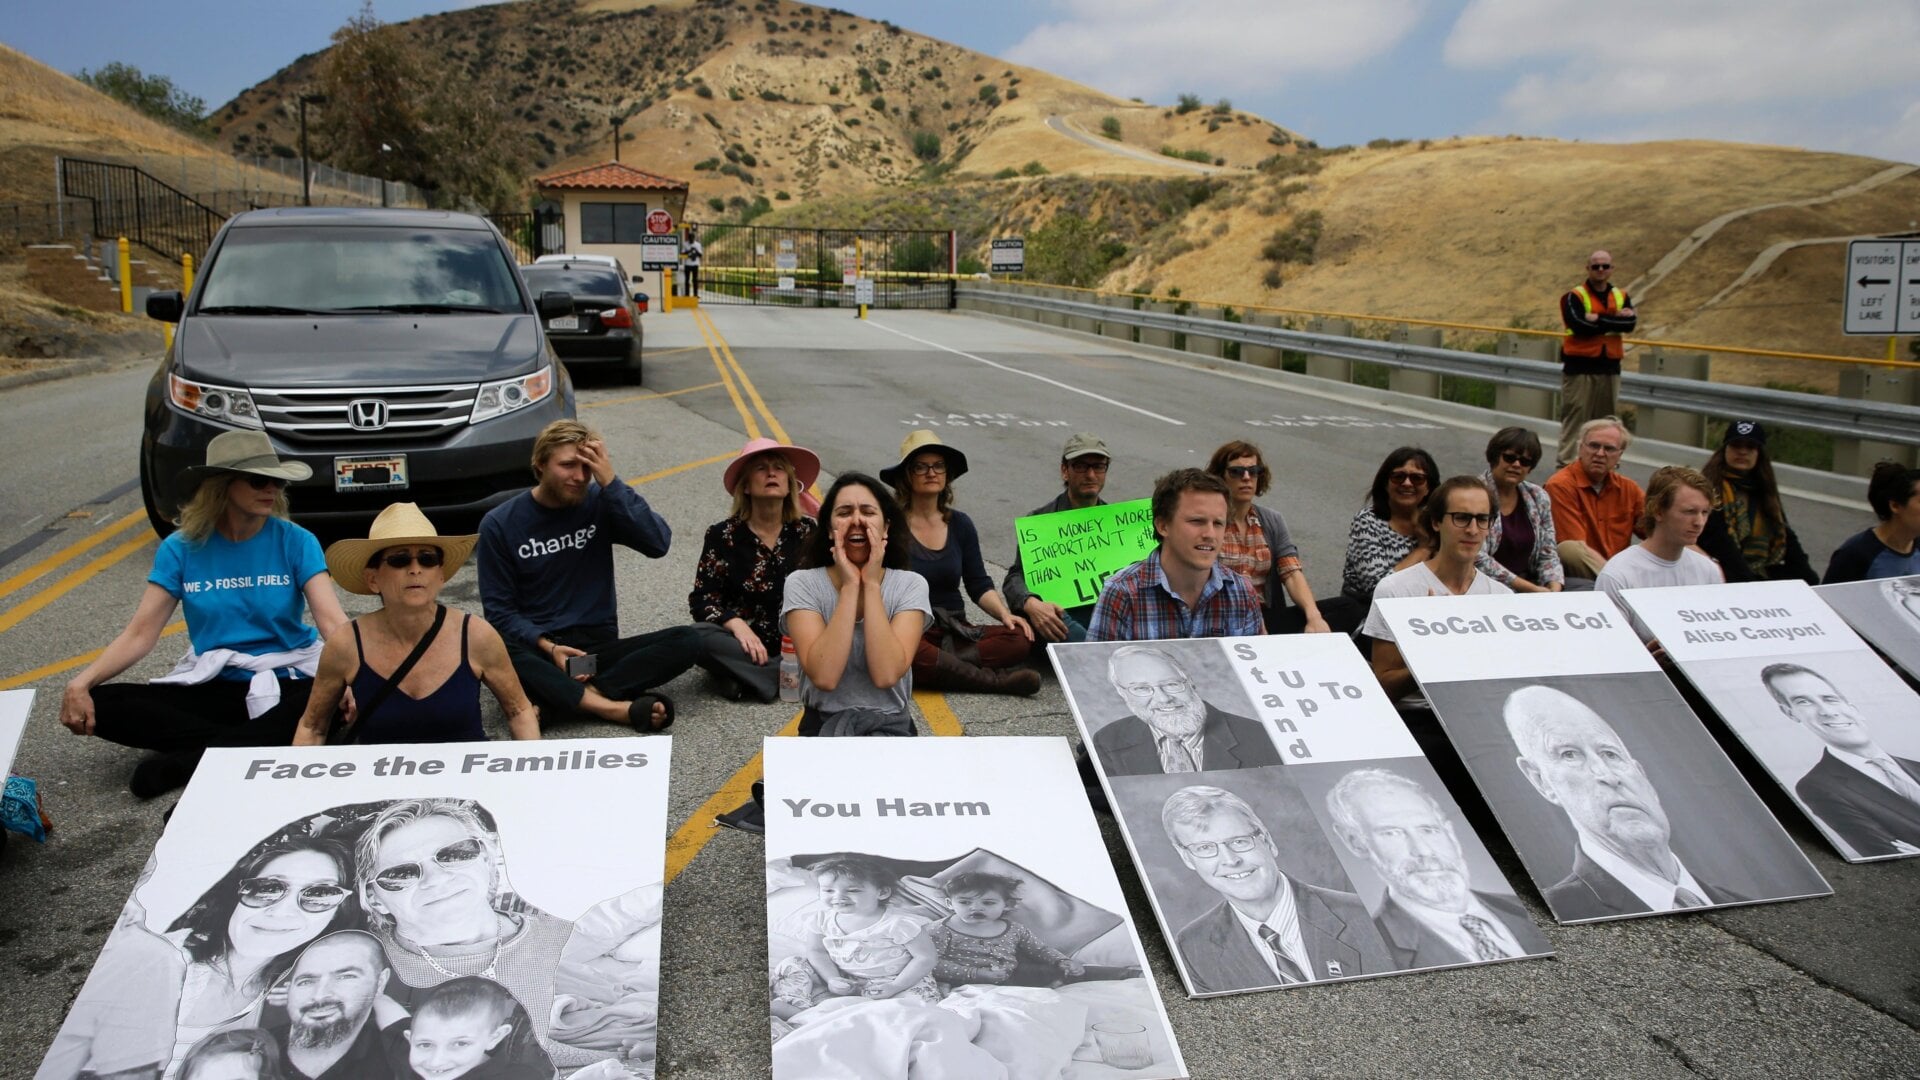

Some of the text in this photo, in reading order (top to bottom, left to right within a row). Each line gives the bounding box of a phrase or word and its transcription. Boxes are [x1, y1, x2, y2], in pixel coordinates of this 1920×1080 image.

[650, 215, 668, 224] STOP
[1856, 256, 1895, 264] VISITORS
[1861, 298, 1882, 306] LEFT
[1860, 311, 1882, 320] LANE
[1020, 508, 1153, 544] IS MONEY MORE
[518, 524, 596, 559] change
[1030, 530, 1125, 564] IMPORTANT
[1027, 557, 1096, 587] THAN MY
[184, 582, 200, 593] WE
[216, 577, 254, 589] FOSSIL
[257, 575, 290, 586] FUELS
[1408, 612, 1613, 636] SoCal Gas Co!
[1677, 607, 1792, 623] Shut Down
[1683, 622, 1826, 644] Aliso Canyon!
[1318, 682, 1363, 700] To
[244, 750, 649, 780] Face the Families
[781, 797, 991, 818] You Harm
